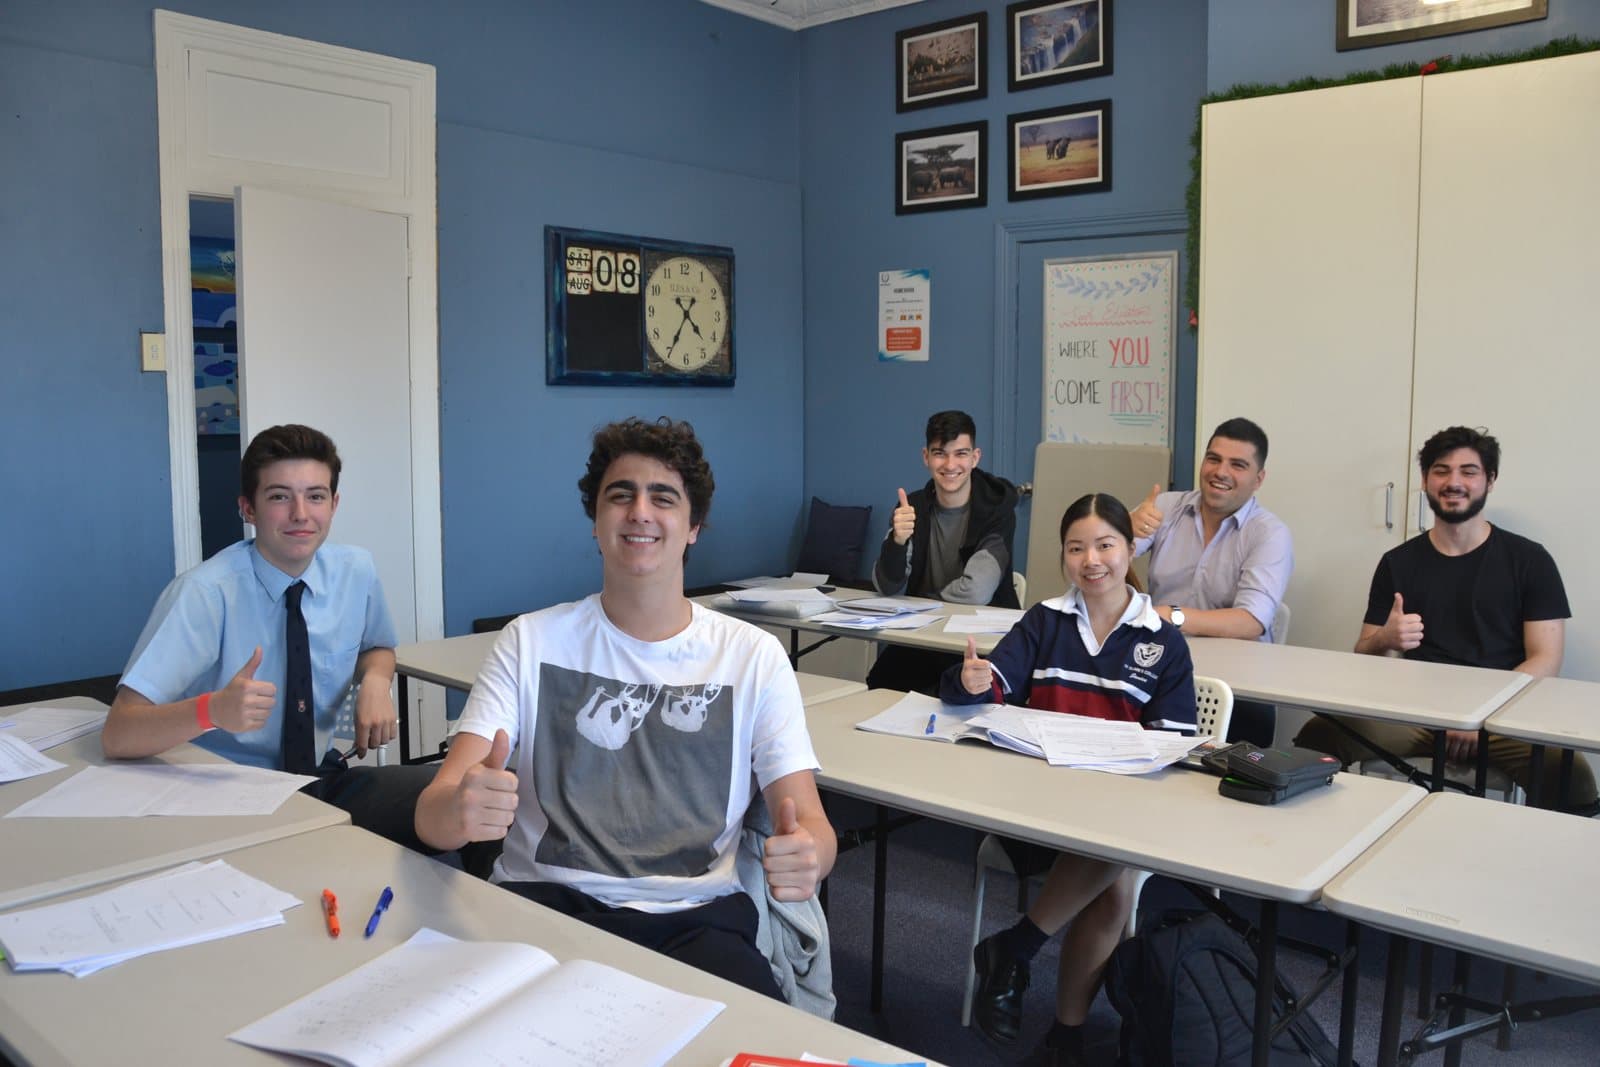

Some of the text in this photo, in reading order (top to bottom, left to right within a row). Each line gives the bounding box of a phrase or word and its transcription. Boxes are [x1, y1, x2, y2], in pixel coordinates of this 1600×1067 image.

[568, 251, 636, 288] SAT 08
[663, 267, 671, 279] 11
[680, 263, 690, 275] 12
[700, 271, 704, 282] 1
[569, 277, 590, 290] AUG
[651, 284, 661, 296] 10
[710, 288, 717, 300] 2
[648, 305, 655, 318] 9
[714, 311, 721, 323] 3
[653, 328, 660, 340] 8
[710, 331, 717, 343] 4
[666, 346, 673, 359] 7
[700, 348, 706, 360] 5
[1058, 336, 1150, 367] WHERE YOU
[683, 353, 689, 366] 6
[1054, 379, 1161, 414] COME FIRST!
